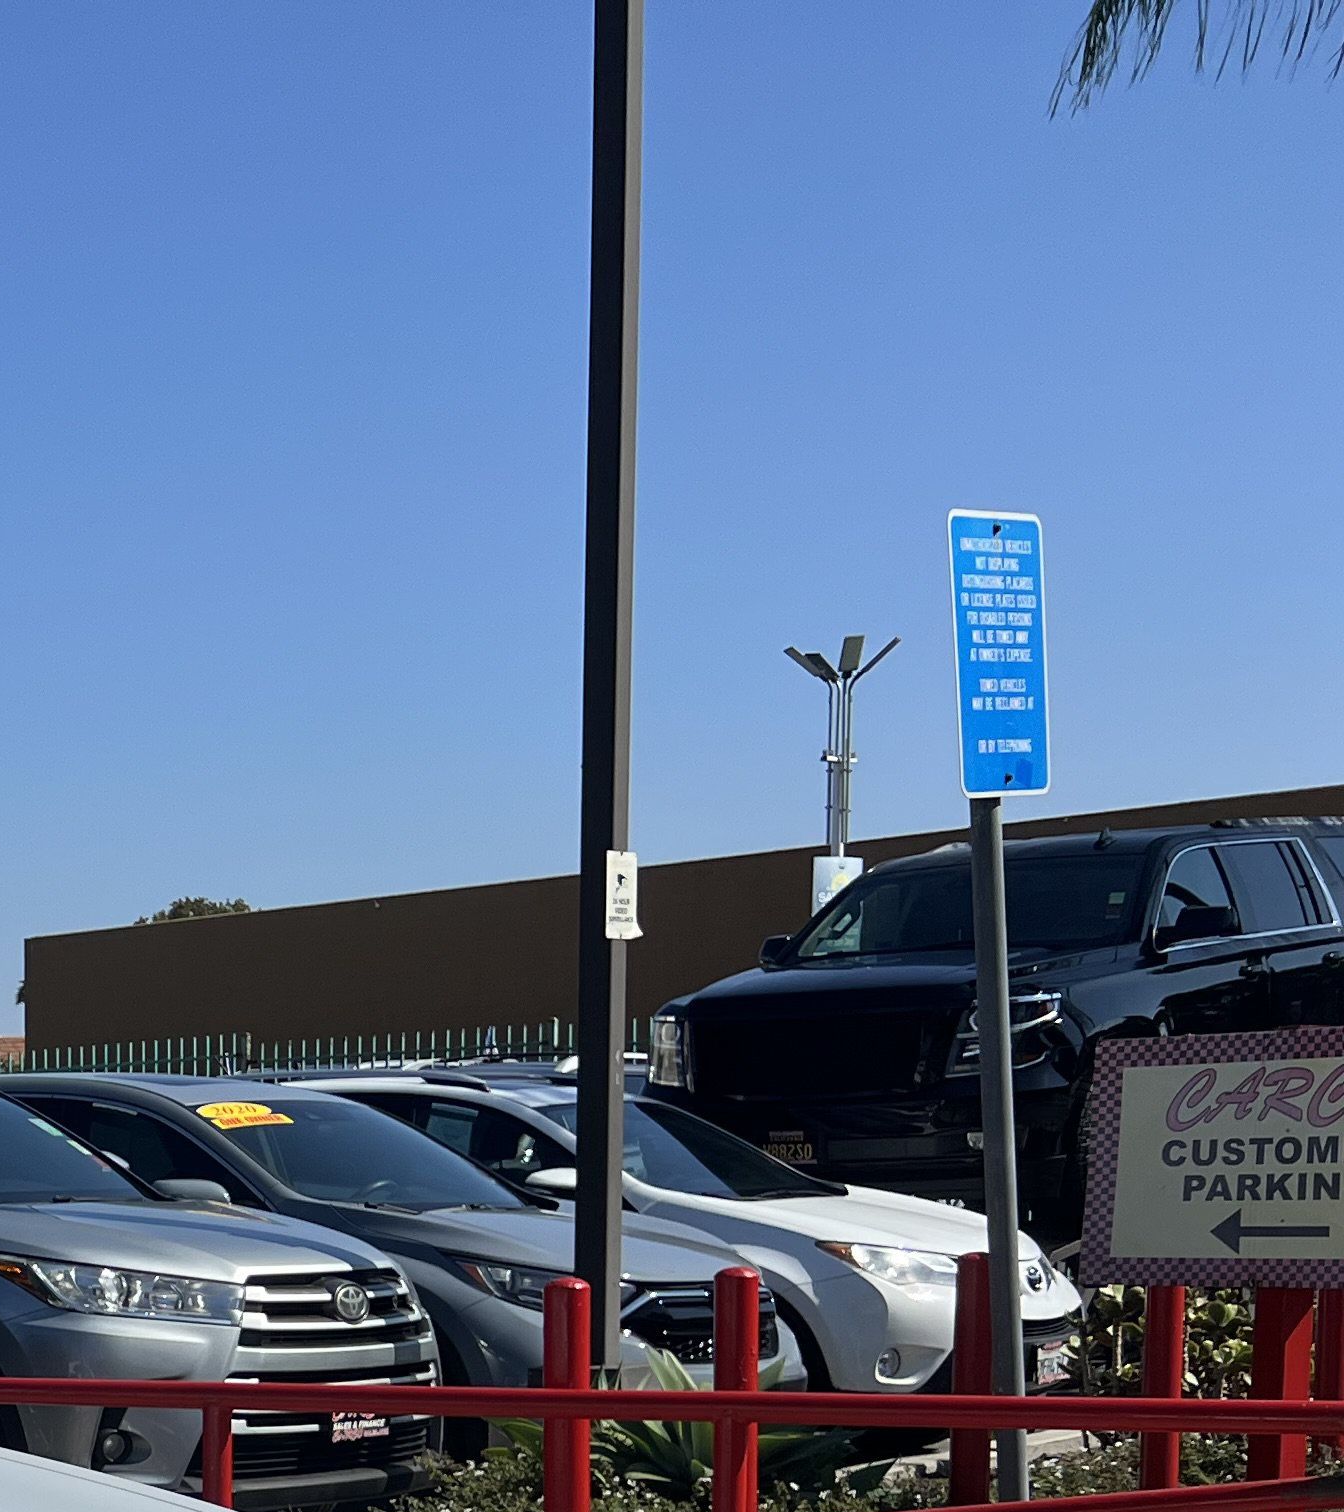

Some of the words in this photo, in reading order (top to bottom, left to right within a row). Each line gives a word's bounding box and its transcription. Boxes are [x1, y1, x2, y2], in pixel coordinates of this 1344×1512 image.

[213, 1105, 257, 1117] 2020
[1165, 1063, 1344, 1133] CARC
[1161, 1135, 1344, 1168] CUSTOM
[1181, 1172, 1342, 1202] PARKIN
